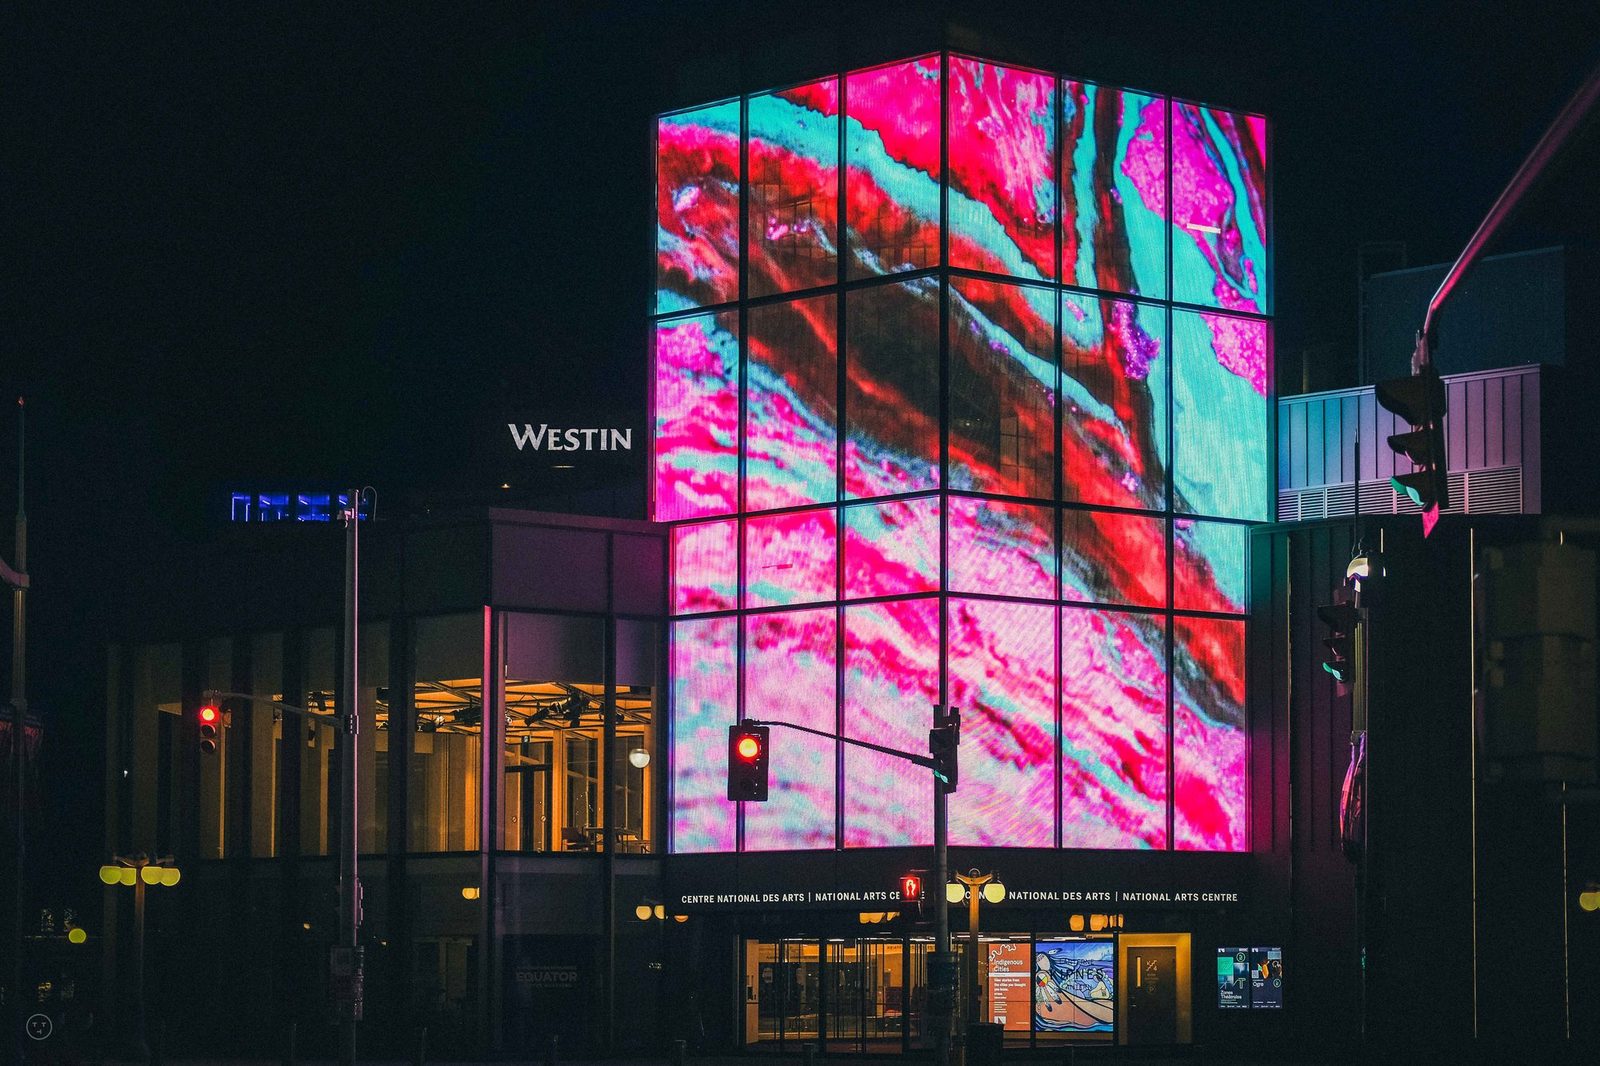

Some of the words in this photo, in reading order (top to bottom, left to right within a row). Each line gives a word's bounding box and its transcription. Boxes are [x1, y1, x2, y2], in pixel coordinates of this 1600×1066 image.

[681, 894, 715, 904] CENTRE
[717, 893, 761, 903] NATIONAL
[762, 893, 780, 903] DES
[781, 893, 805, 902] ARTS
[815, 892, 861, 902] NATIONAL
[863, 891, 887, 901] ARTS
[1008, 891, 1060, 901] NATIONAL
[1062, 891, 1083, 901] DES
[1085, 891, 1111, 901] ARTS
[1122, 892, 1171, 902] NATIONAL
[1174, 892, 1199, 902] ARTS
[1201, 893, 1238, 902] CENTRE
